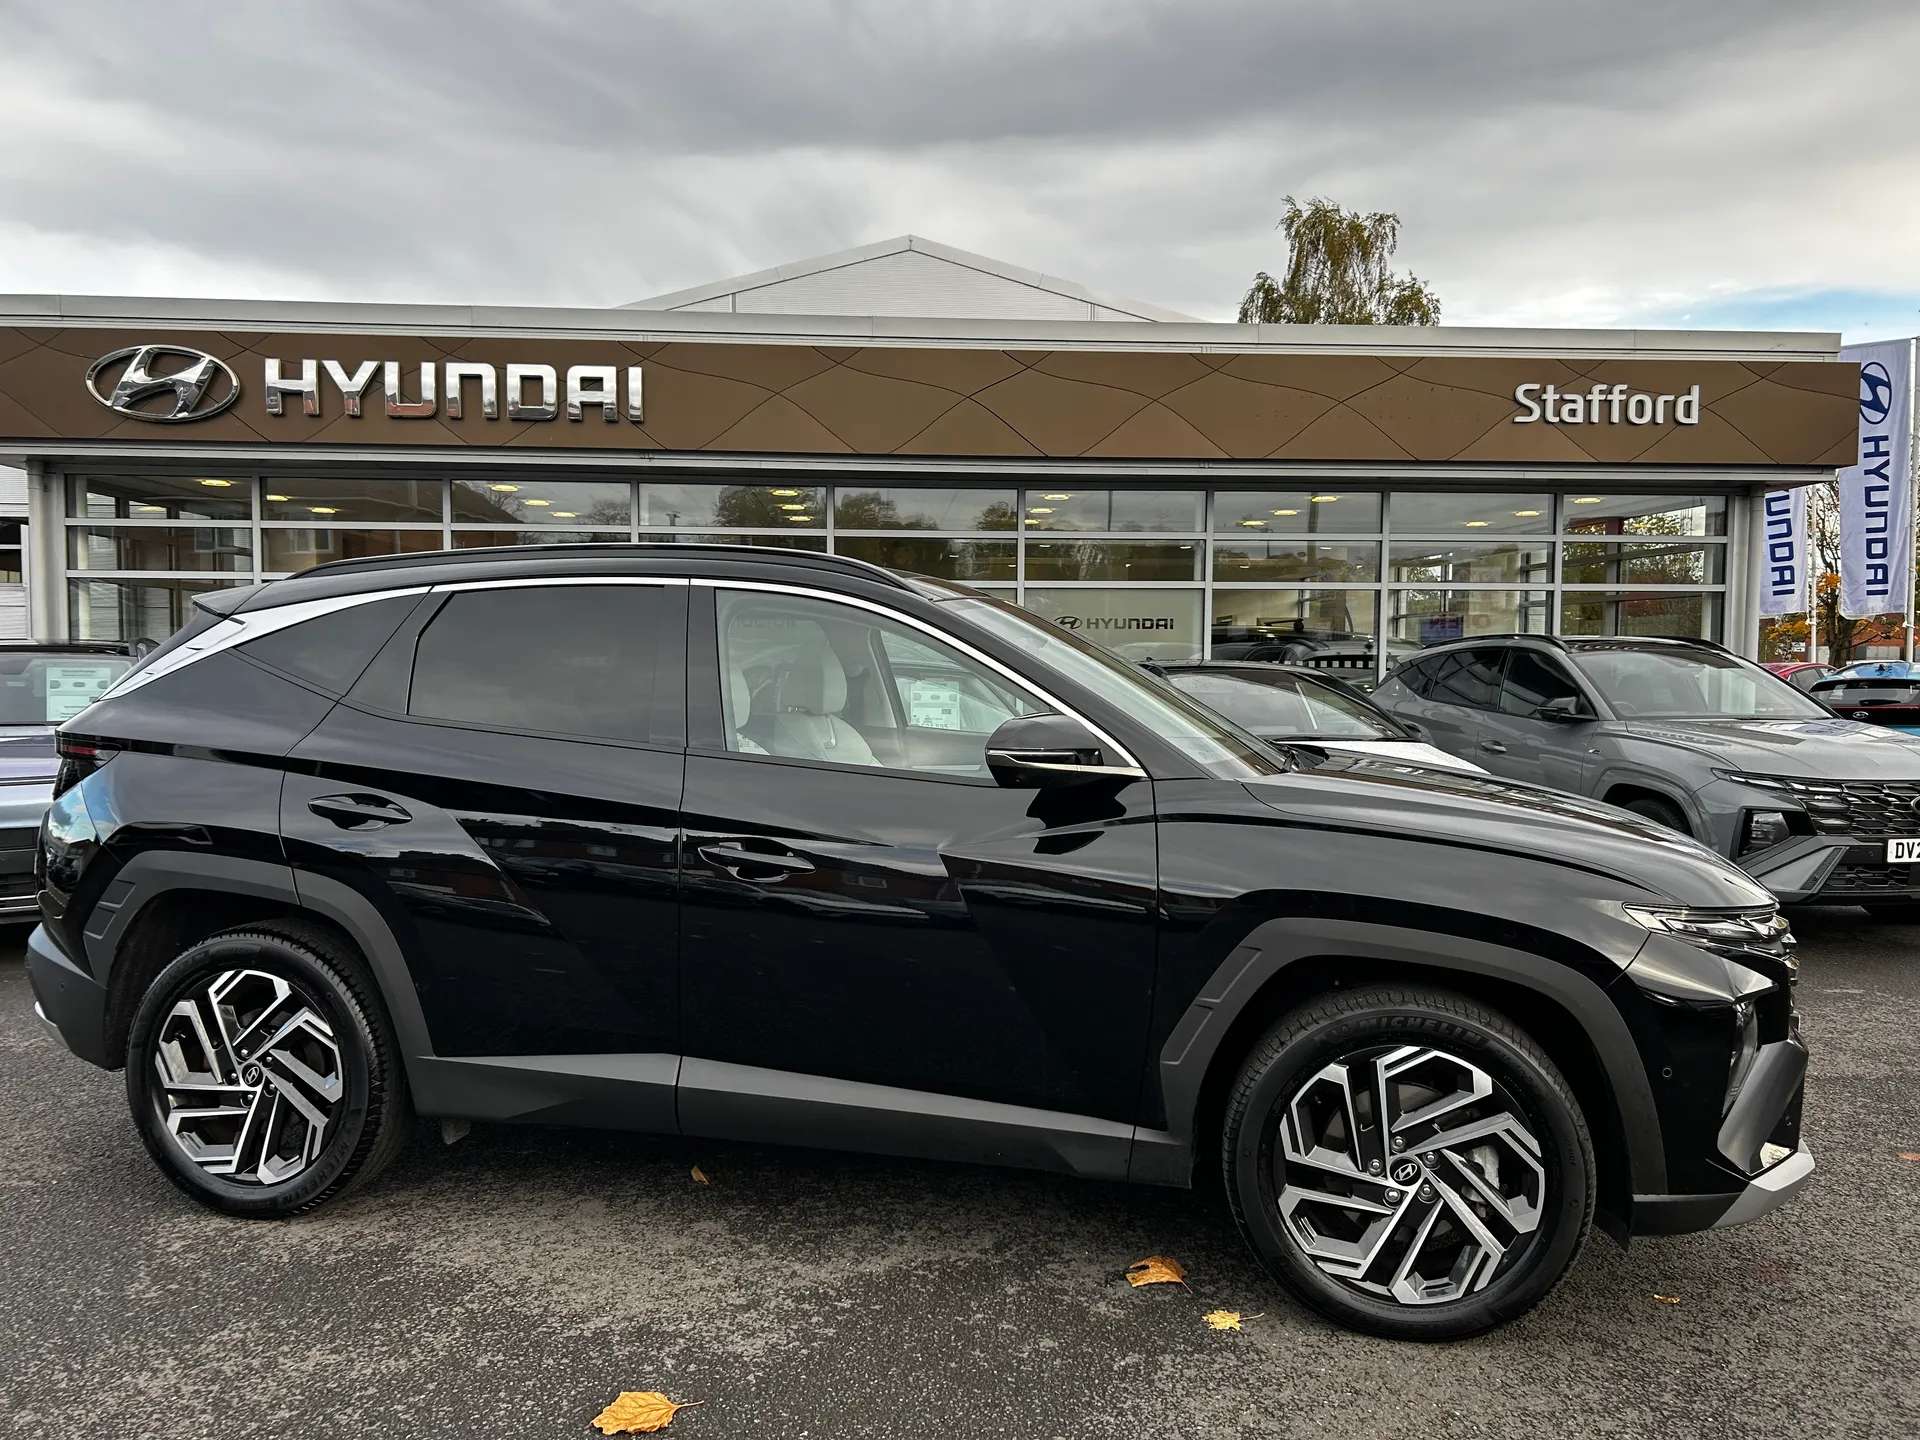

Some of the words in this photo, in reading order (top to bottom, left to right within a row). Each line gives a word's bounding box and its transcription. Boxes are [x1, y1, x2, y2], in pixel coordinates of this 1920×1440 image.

[265, 358, 643, 423] HYUNDAI
[1513, 383, 1700, 425] Stafford
[1765, 492, 1796, 596] UNDAI
[1863, 435, 1890, 596] HYUNDAI
[1086, 618, 1174, 630] HYUNDAI
